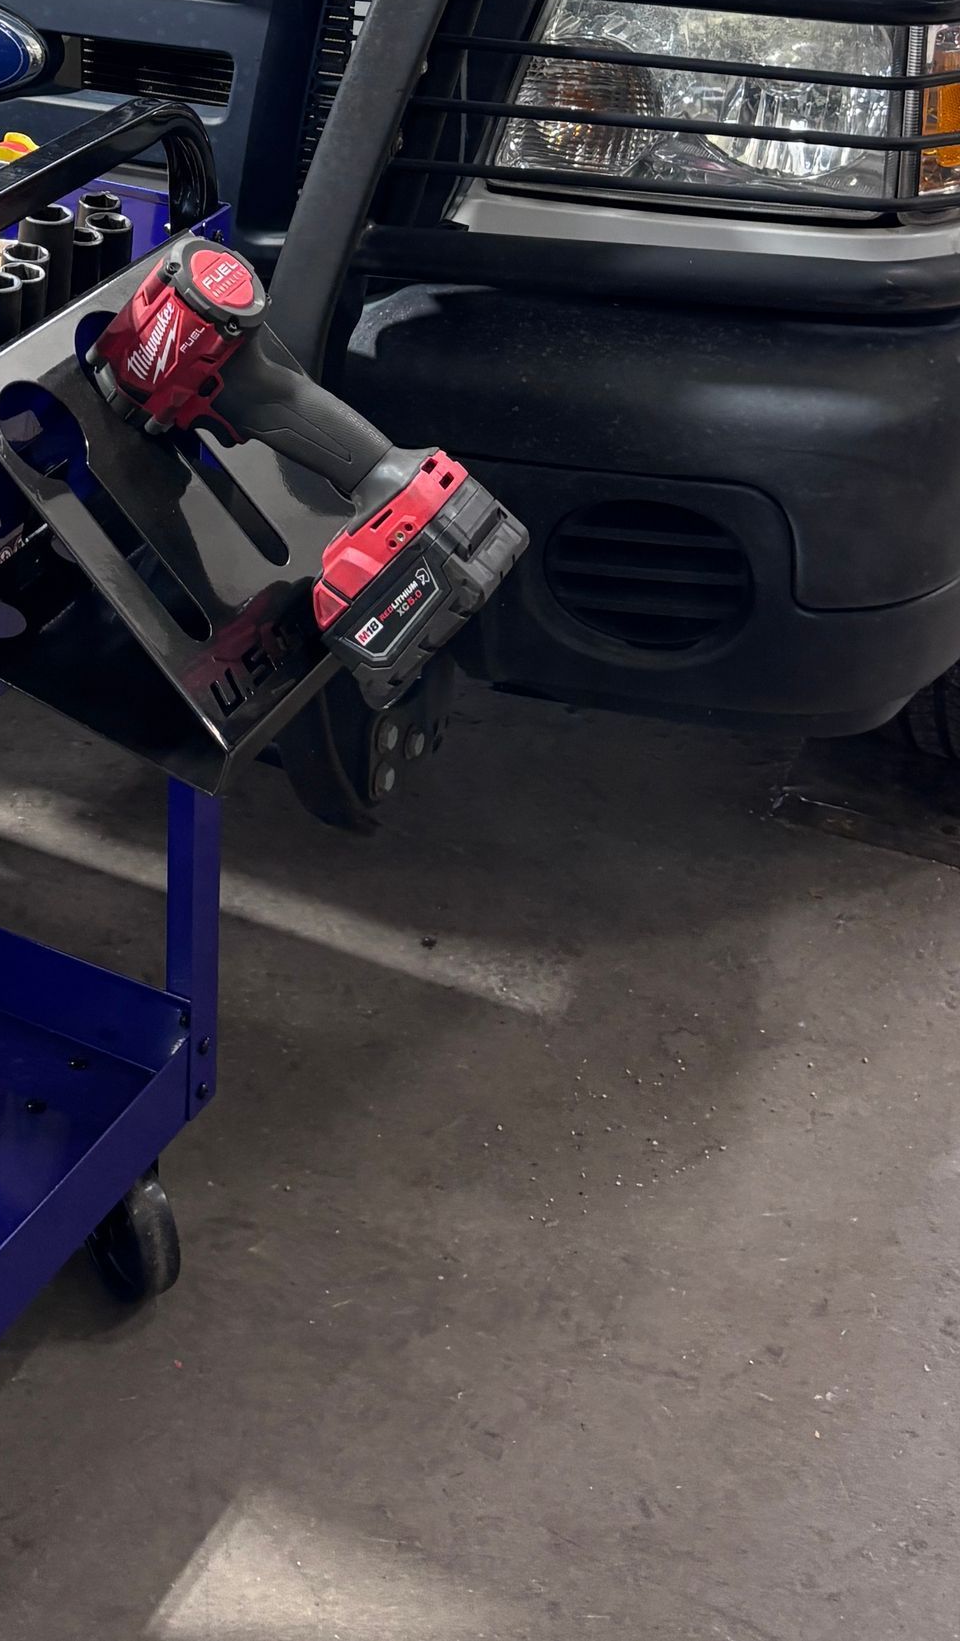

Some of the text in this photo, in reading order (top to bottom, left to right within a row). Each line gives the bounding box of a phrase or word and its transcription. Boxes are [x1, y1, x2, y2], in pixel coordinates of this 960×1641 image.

[201, 261, 240, 291] FUEL
[127, 301, 176, 381] Milwaukee
[179, 326, 206, 354] FUEL
[378, 580, 419, 622] REDLITHIUM
[357, 620, 380, 644] M18
